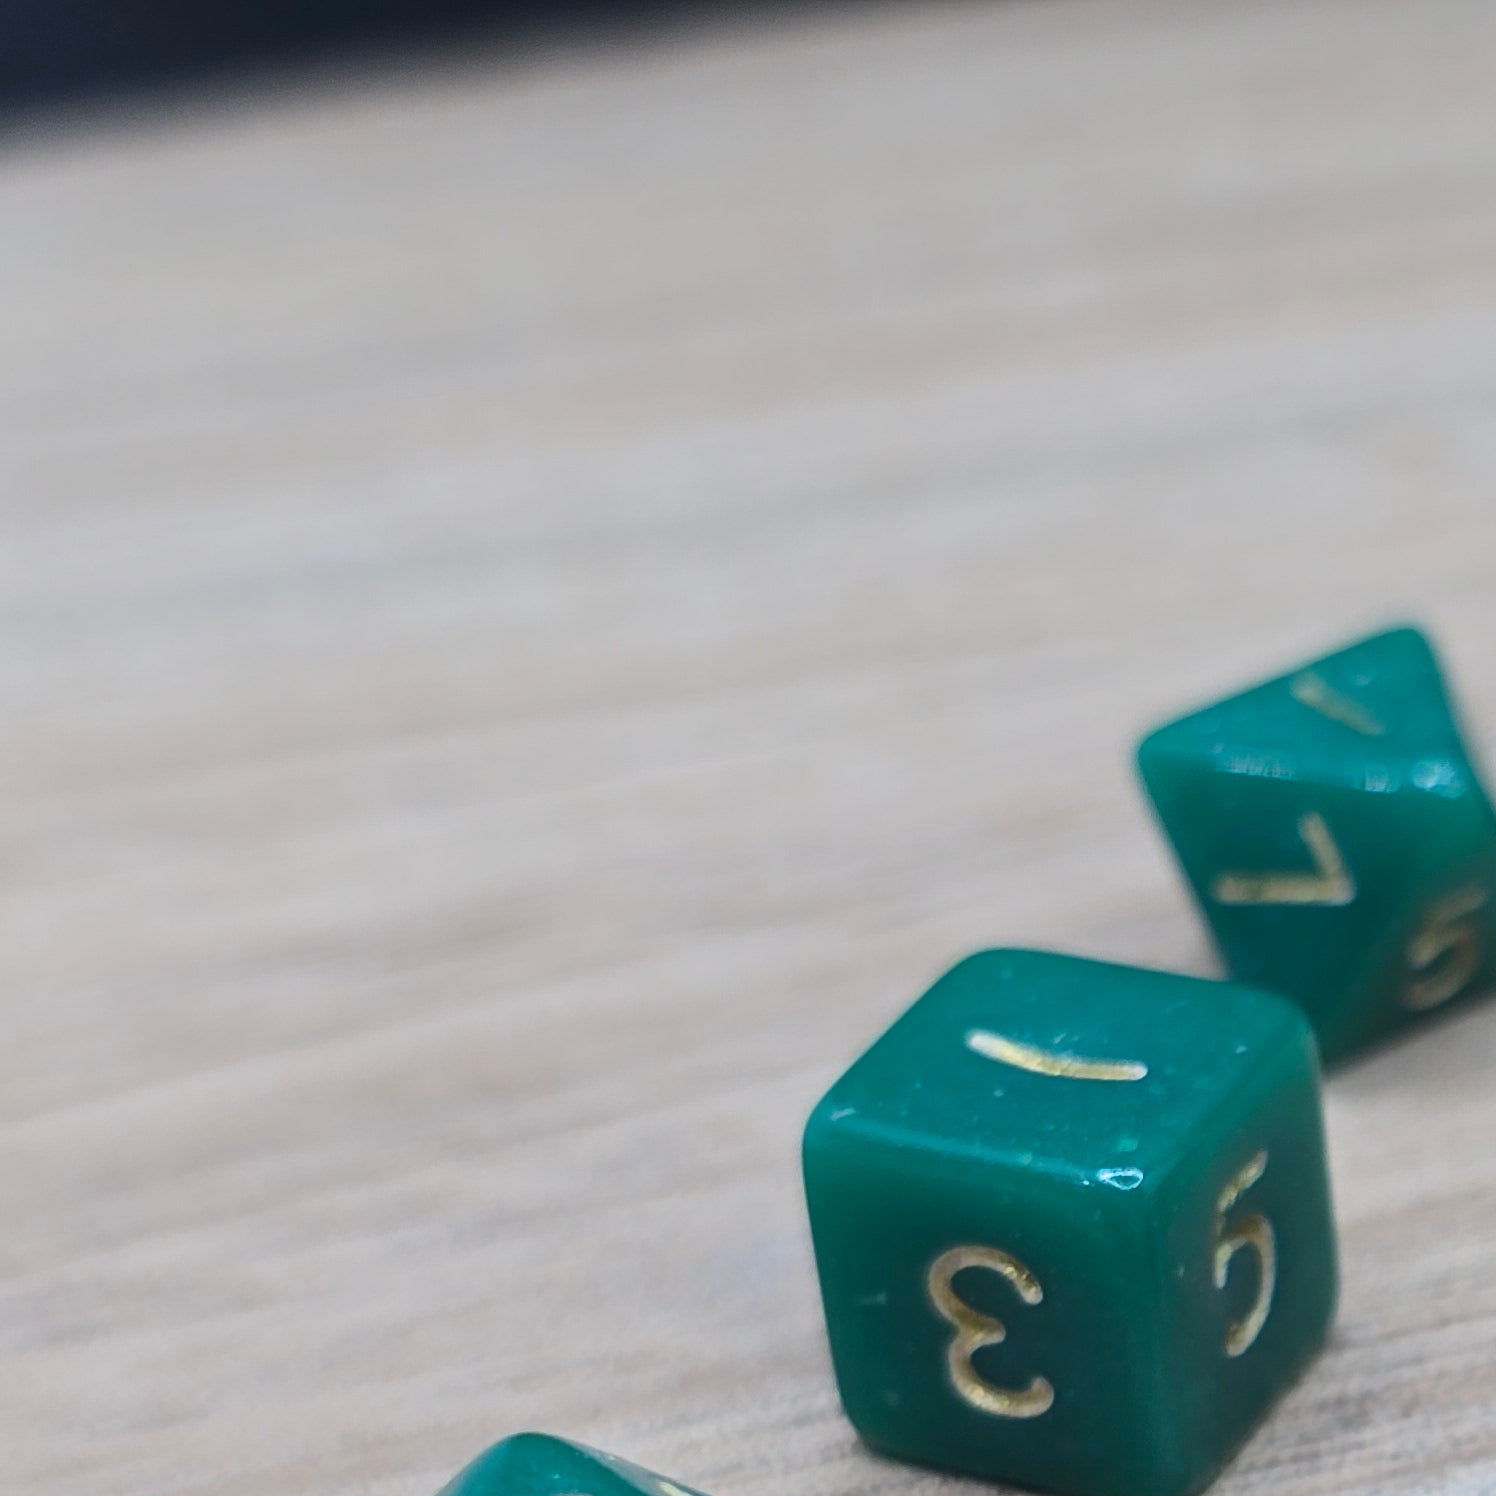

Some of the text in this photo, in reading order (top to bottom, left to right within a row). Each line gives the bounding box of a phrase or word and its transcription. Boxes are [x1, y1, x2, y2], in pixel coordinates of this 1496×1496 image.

[1291, 674, 1387, 737] 1
[965, 1029, 1148, 1081] 1
[1212, 1150, 1276, 1358] 5
[928, 1244, 1055, 1419] 3
